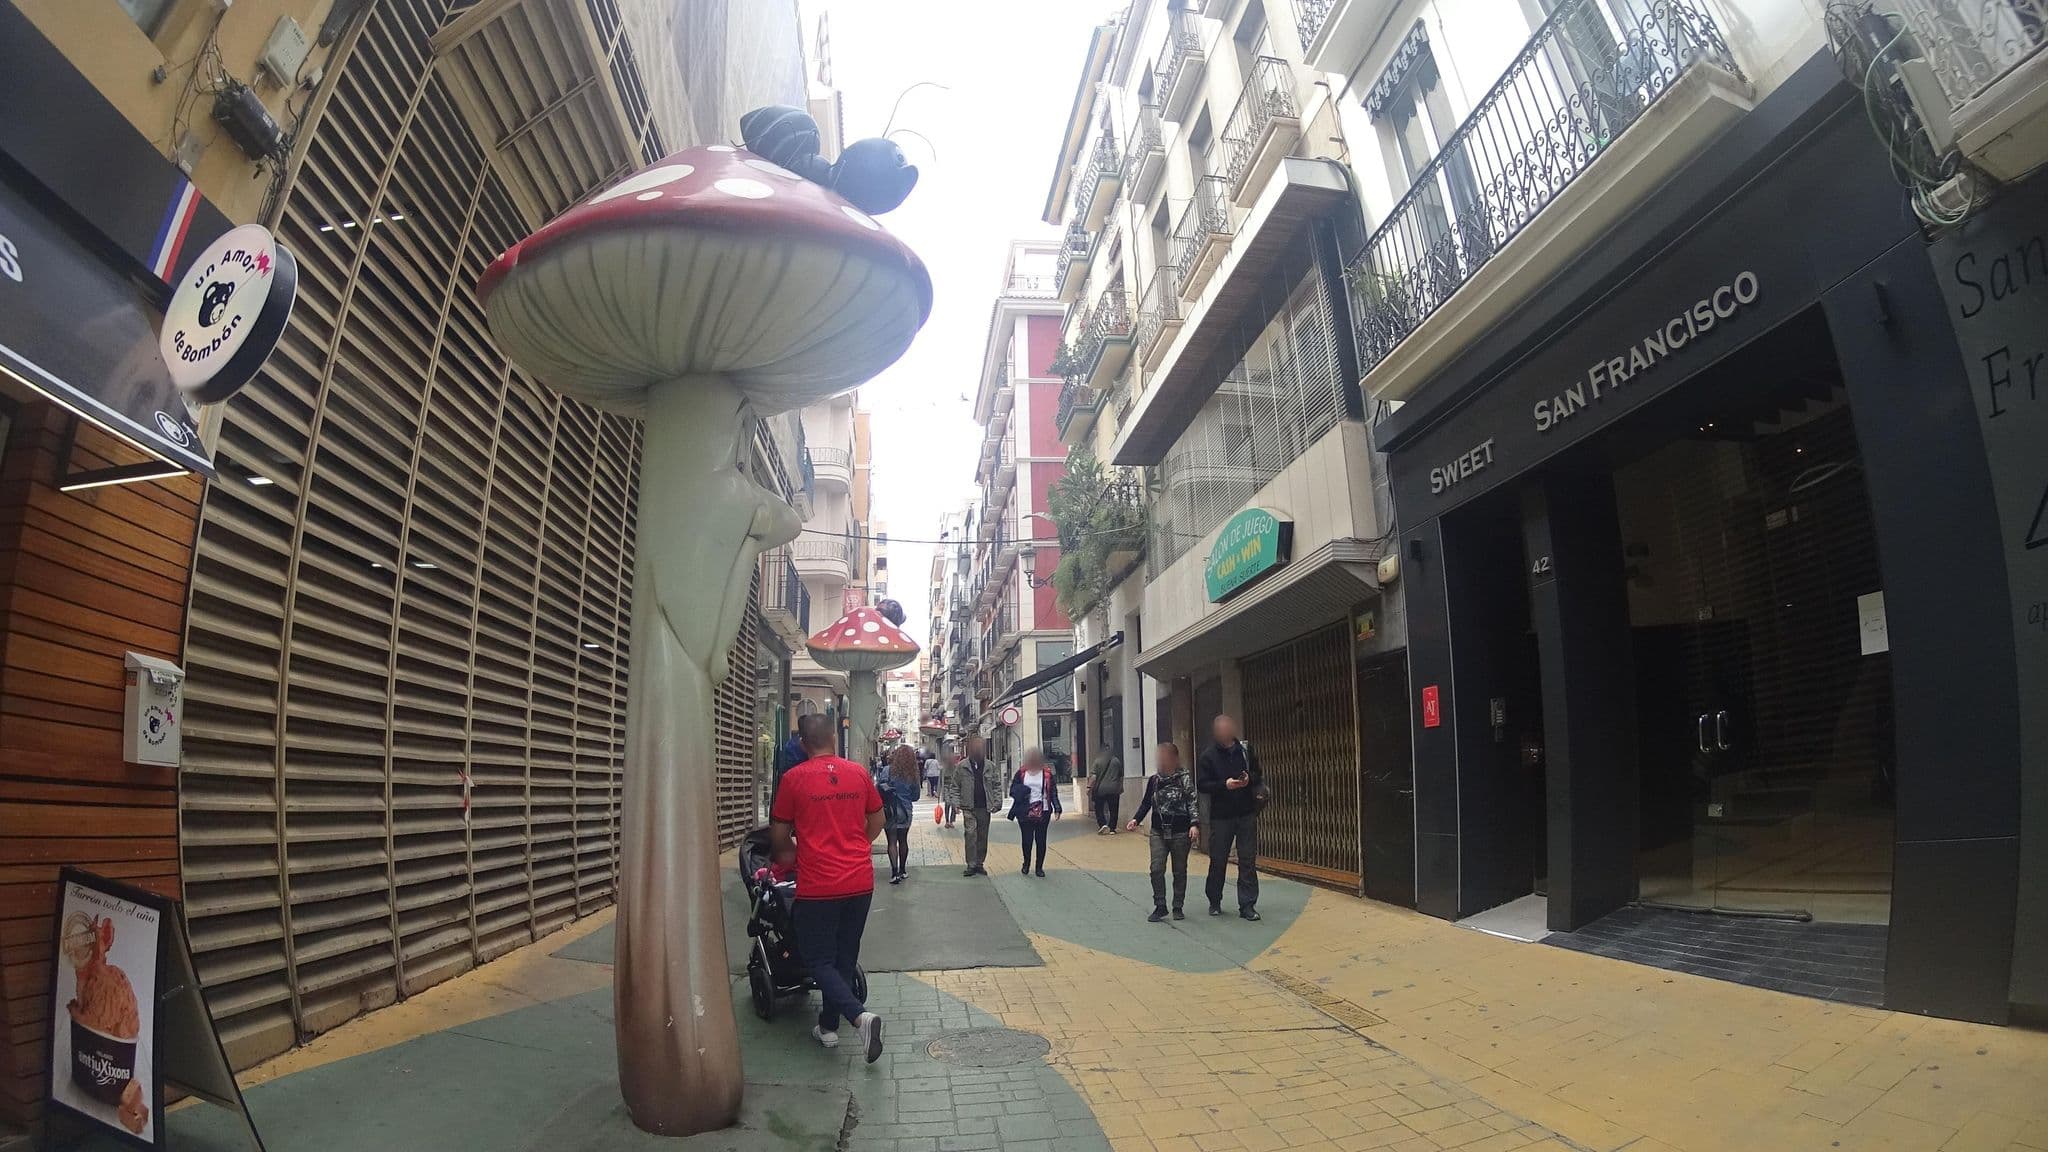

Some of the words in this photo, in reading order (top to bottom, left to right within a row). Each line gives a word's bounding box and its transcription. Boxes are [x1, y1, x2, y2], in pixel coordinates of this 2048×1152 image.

[221, 249, 255, 273] Amor
[1430, 437, 1495, 494] SWEET
[1533, 382, 1587, 432] SAN
[1587, 270, 1759, 400] FRANCISCO
[1230, 524, 1242, 547] DE
[1242, 516, 1273, 538] JUEGO
[1241, 535, 1261, 562] WIN
[1533, 556, 1550, 573] 42
